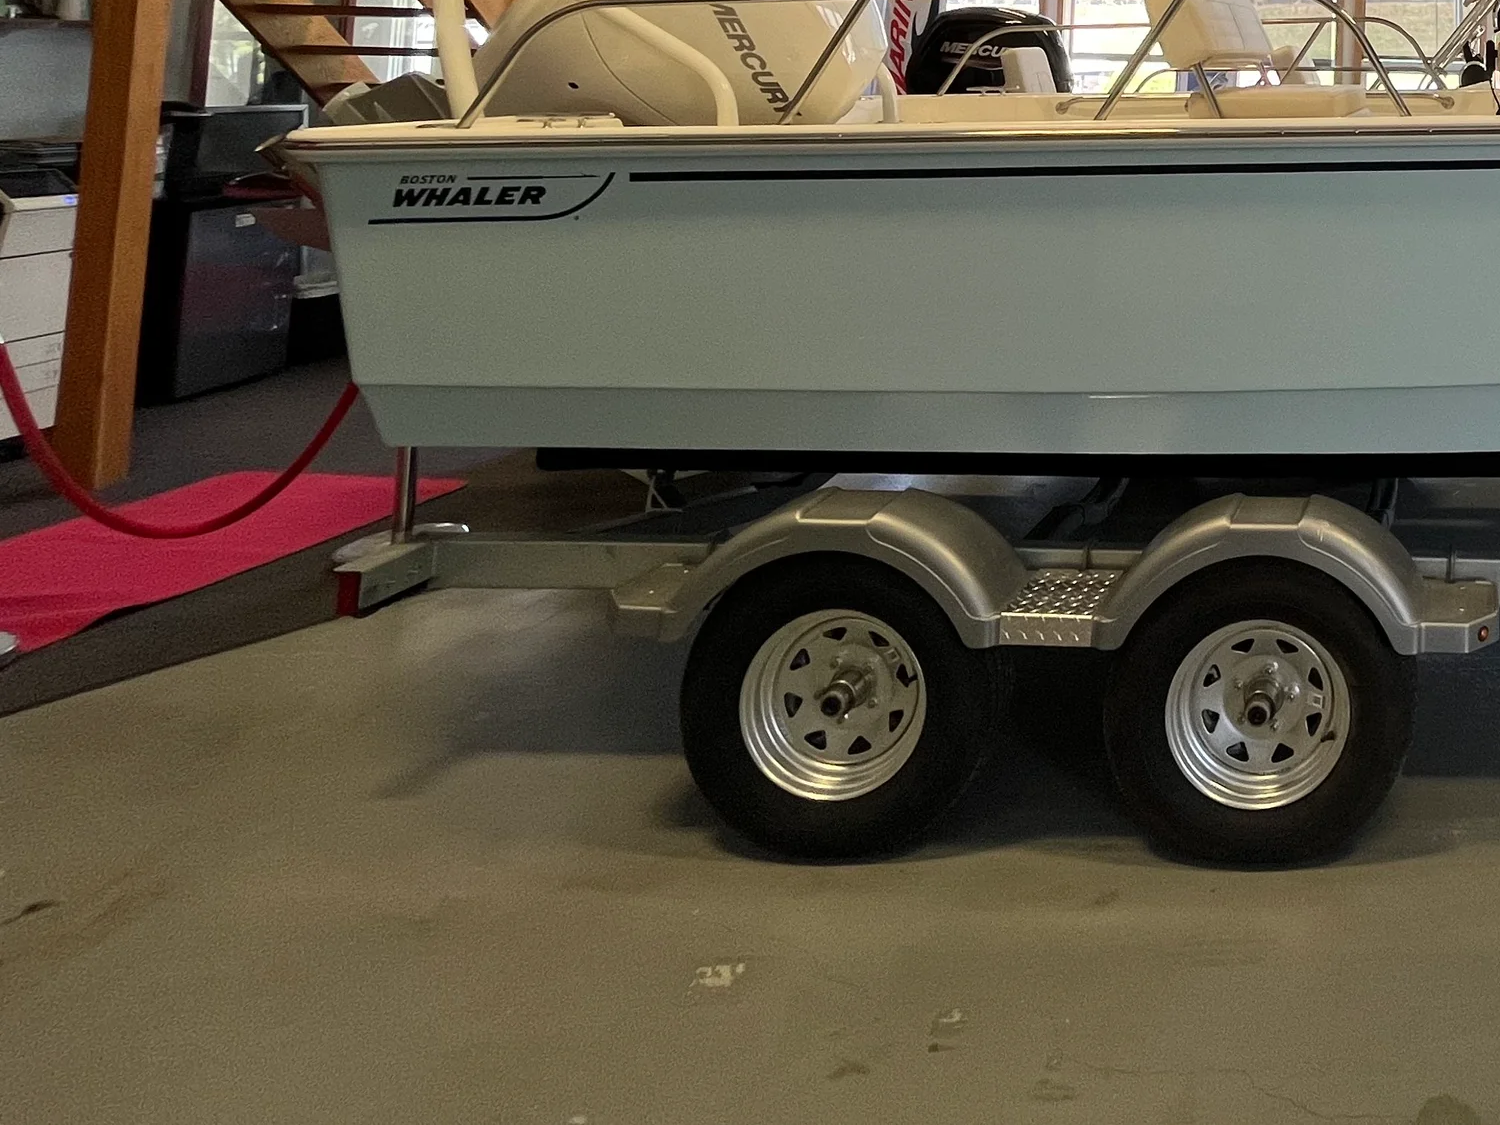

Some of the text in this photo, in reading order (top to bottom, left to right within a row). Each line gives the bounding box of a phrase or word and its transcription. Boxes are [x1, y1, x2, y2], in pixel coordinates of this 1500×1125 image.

[939, 41, 1008, 58] MECU
[400, 174, 457, 185] BOSTON
[392, 185, 547, 208] WHALER
